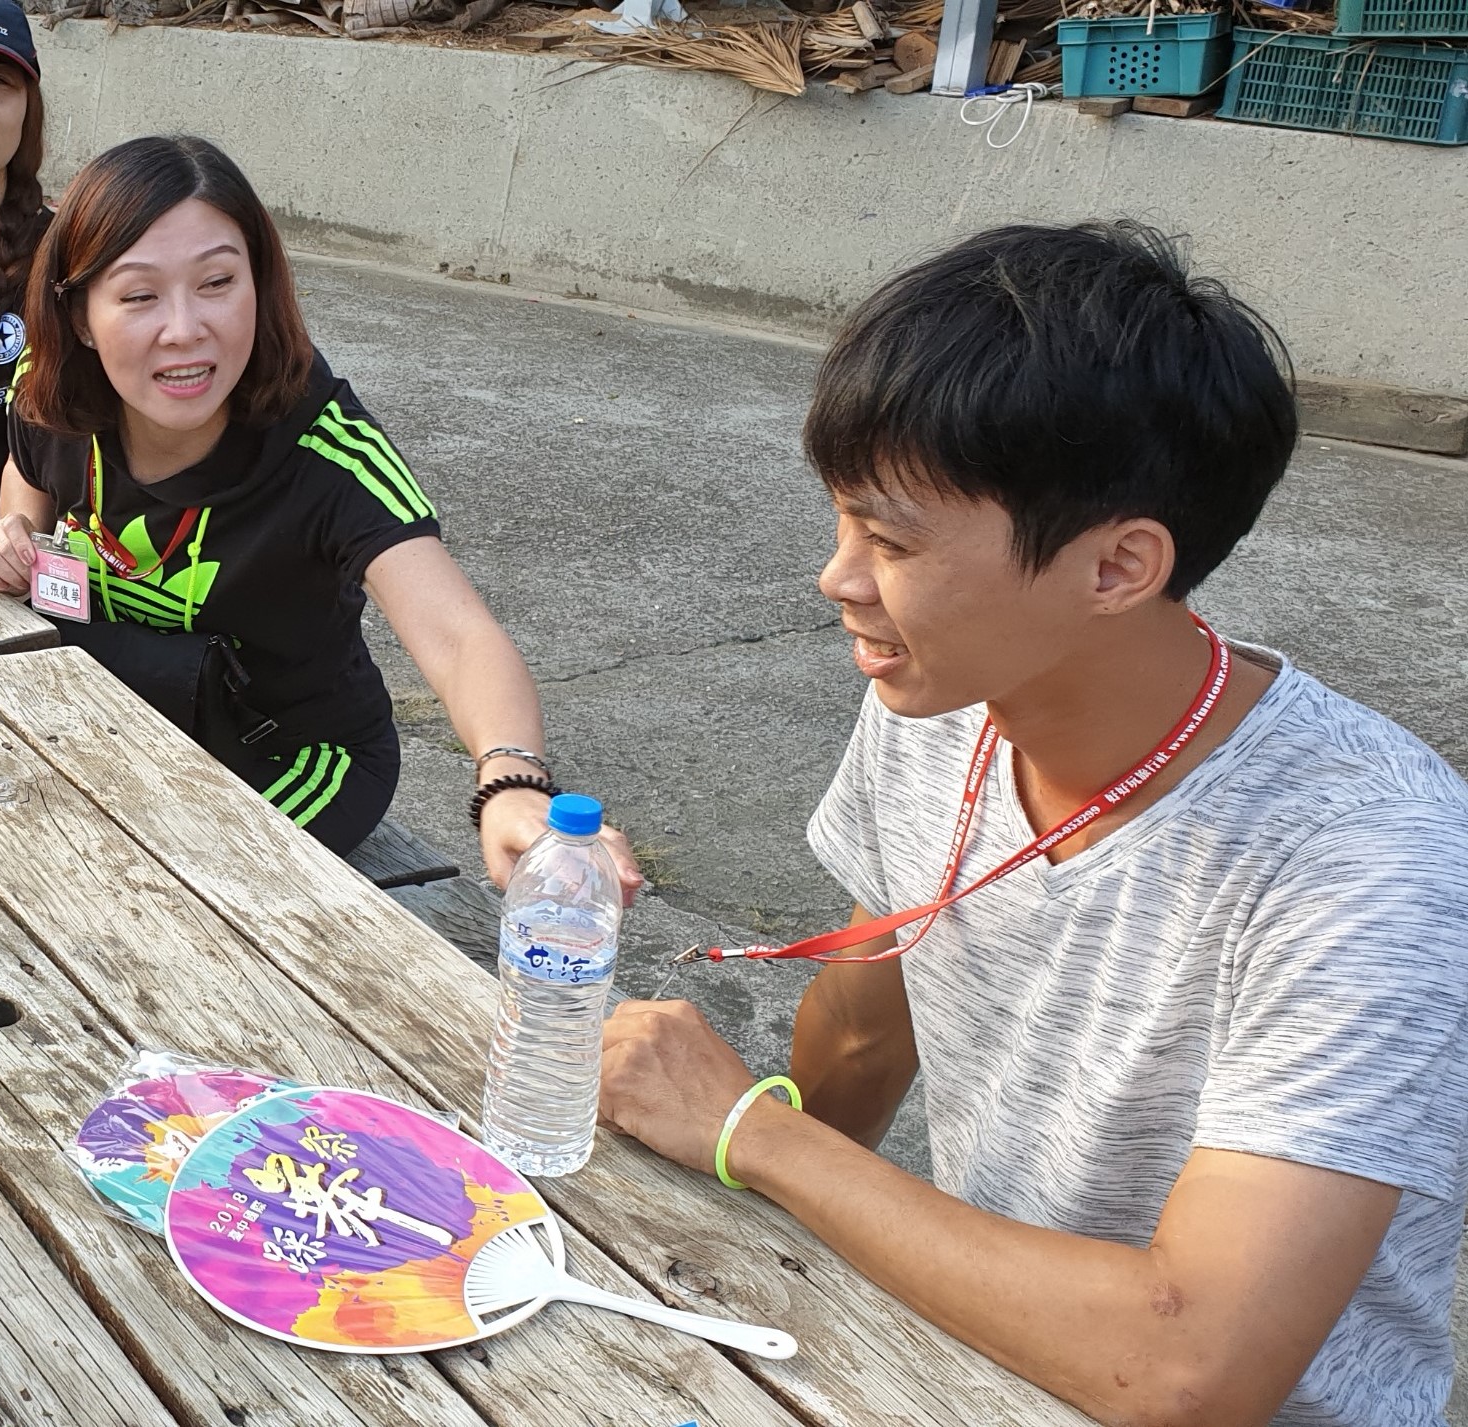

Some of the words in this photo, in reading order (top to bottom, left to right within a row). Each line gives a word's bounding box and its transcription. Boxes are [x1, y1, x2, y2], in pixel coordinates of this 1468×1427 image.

[1036, 805, 1101, 851] 0800-053299
[1103, 751, 1172, 804] 好好玩旅行社
[209, 1191, 249, 1234] 2018
[227, 1199, 268, 1243] 臺中國際
